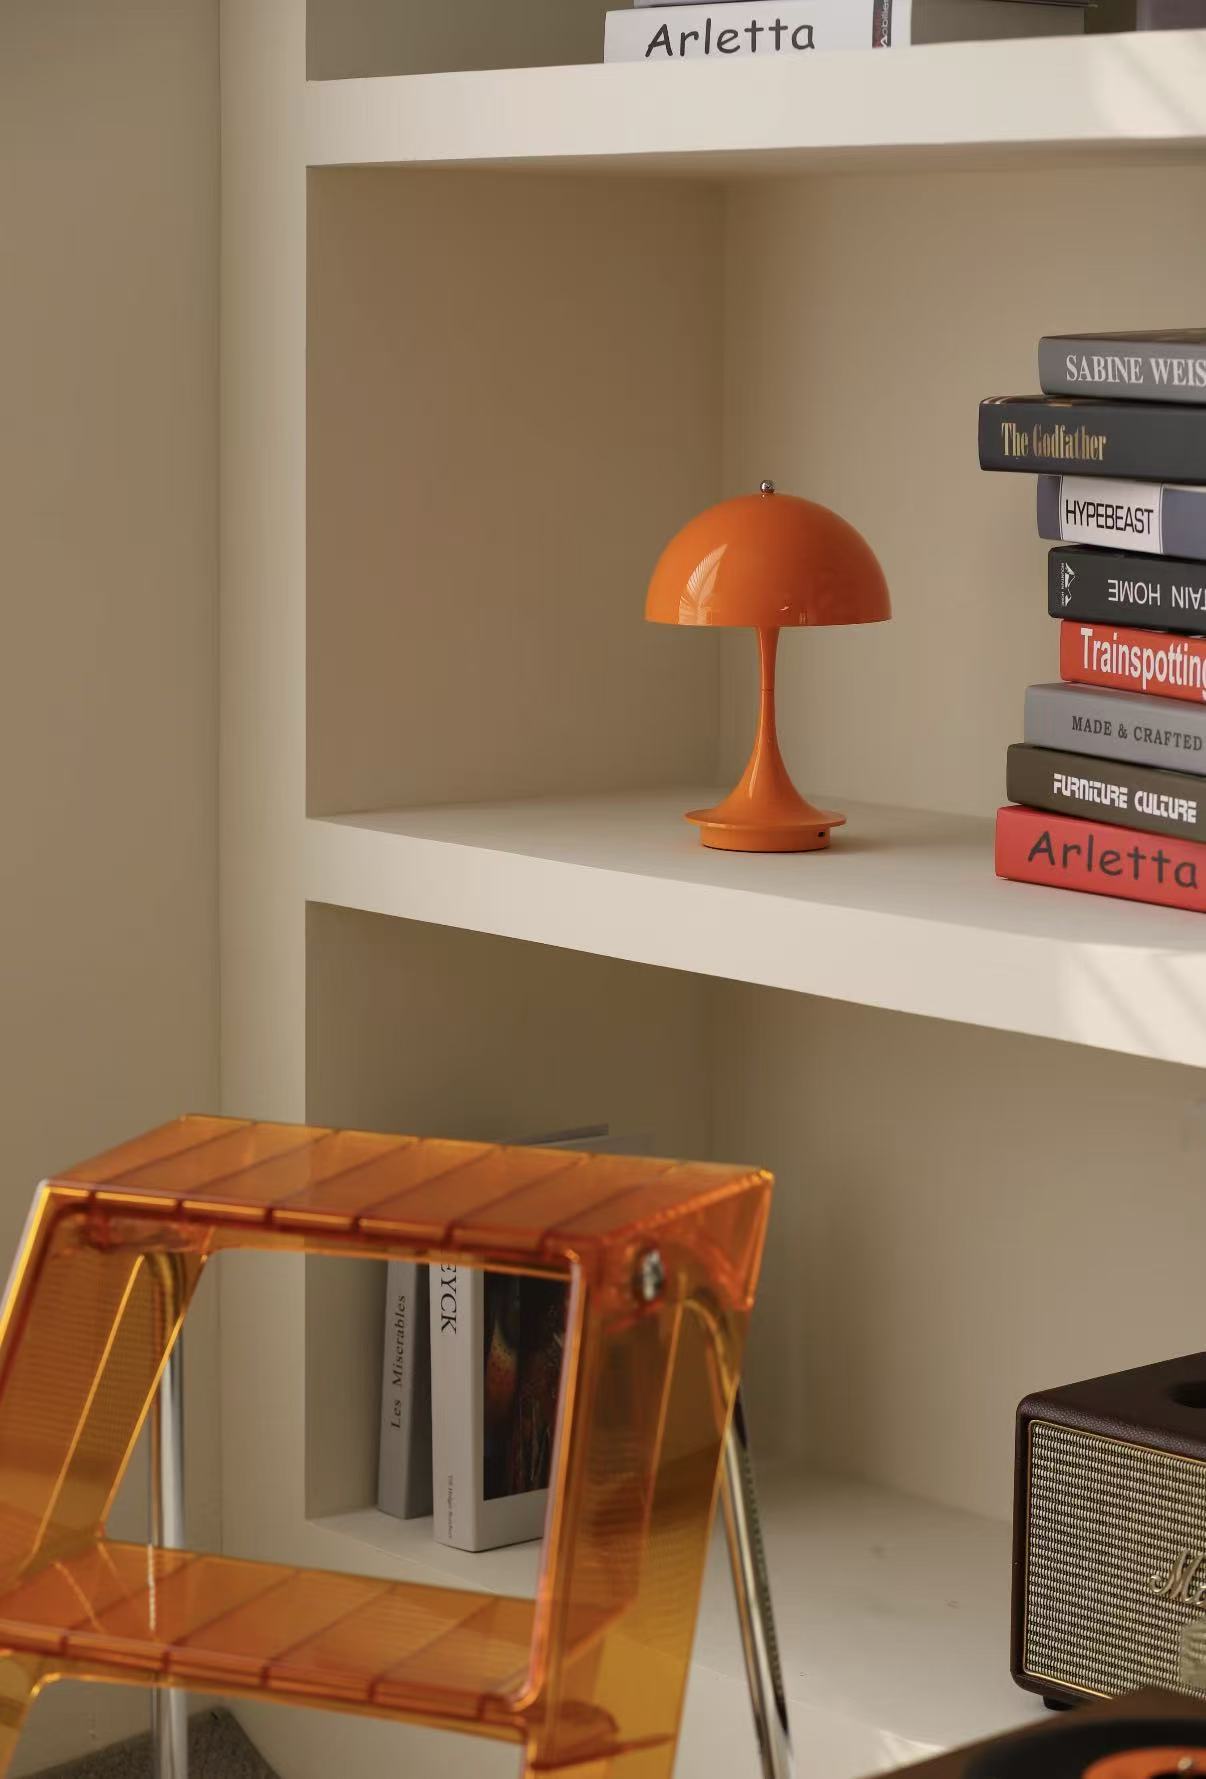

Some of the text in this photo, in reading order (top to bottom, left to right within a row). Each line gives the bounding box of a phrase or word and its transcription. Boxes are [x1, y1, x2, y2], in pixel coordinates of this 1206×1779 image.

[645, 18, 816, 58] Arletta
[1066, 354, 1144, 384] SABINE
[1001, 422, 1107, 461] The Godfather
[1065, 499, 1154, 535] HYPEBEAST
[1107, 579, 1161, 605] HOME
[1071, 715, 1203, 751] MADE & CRAFTED
[1053, 773, 1197, 824] FURNITURE CULTURE
[1028, 830, 1198, 889] Arletta
[390, 1295, 406, 1429] Les Miserables
